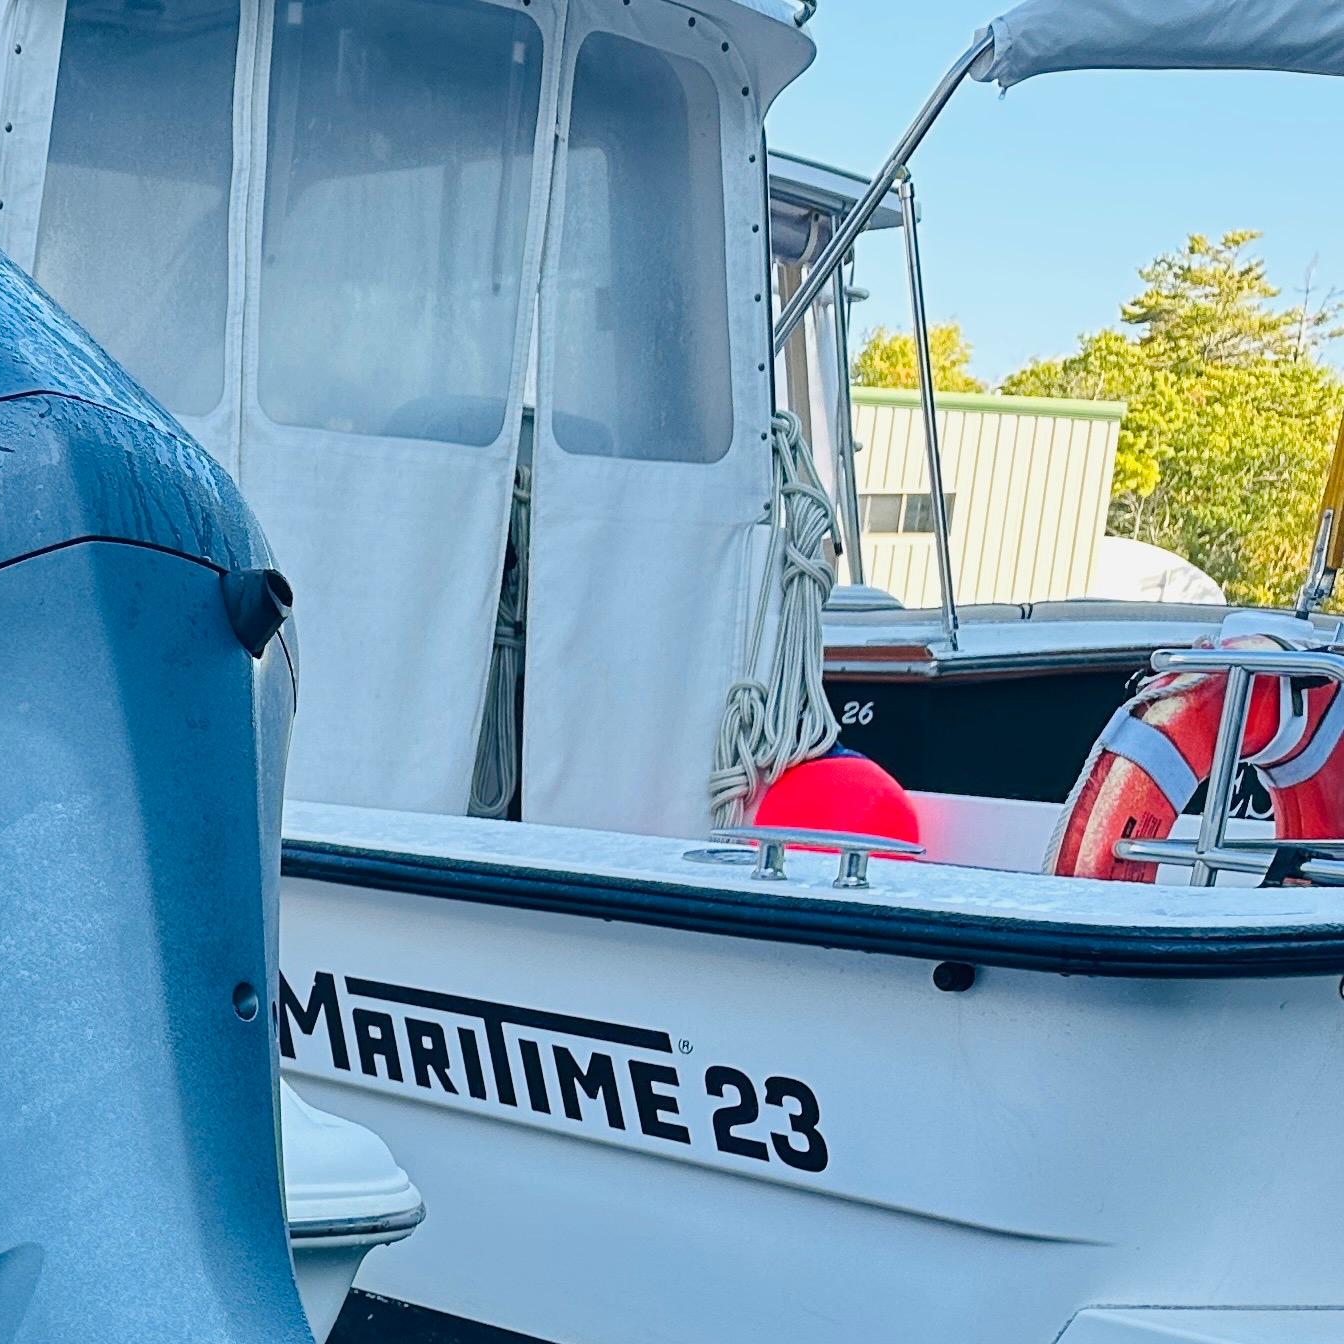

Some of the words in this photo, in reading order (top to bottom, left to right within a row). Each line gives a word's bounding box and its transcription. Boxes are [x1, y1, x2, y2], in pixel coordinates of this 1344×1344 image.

[842, 700, 875, 726] 26
[278, 969, 691, 1145] MARITIME
[705, 1065, 829, 1173] 23
